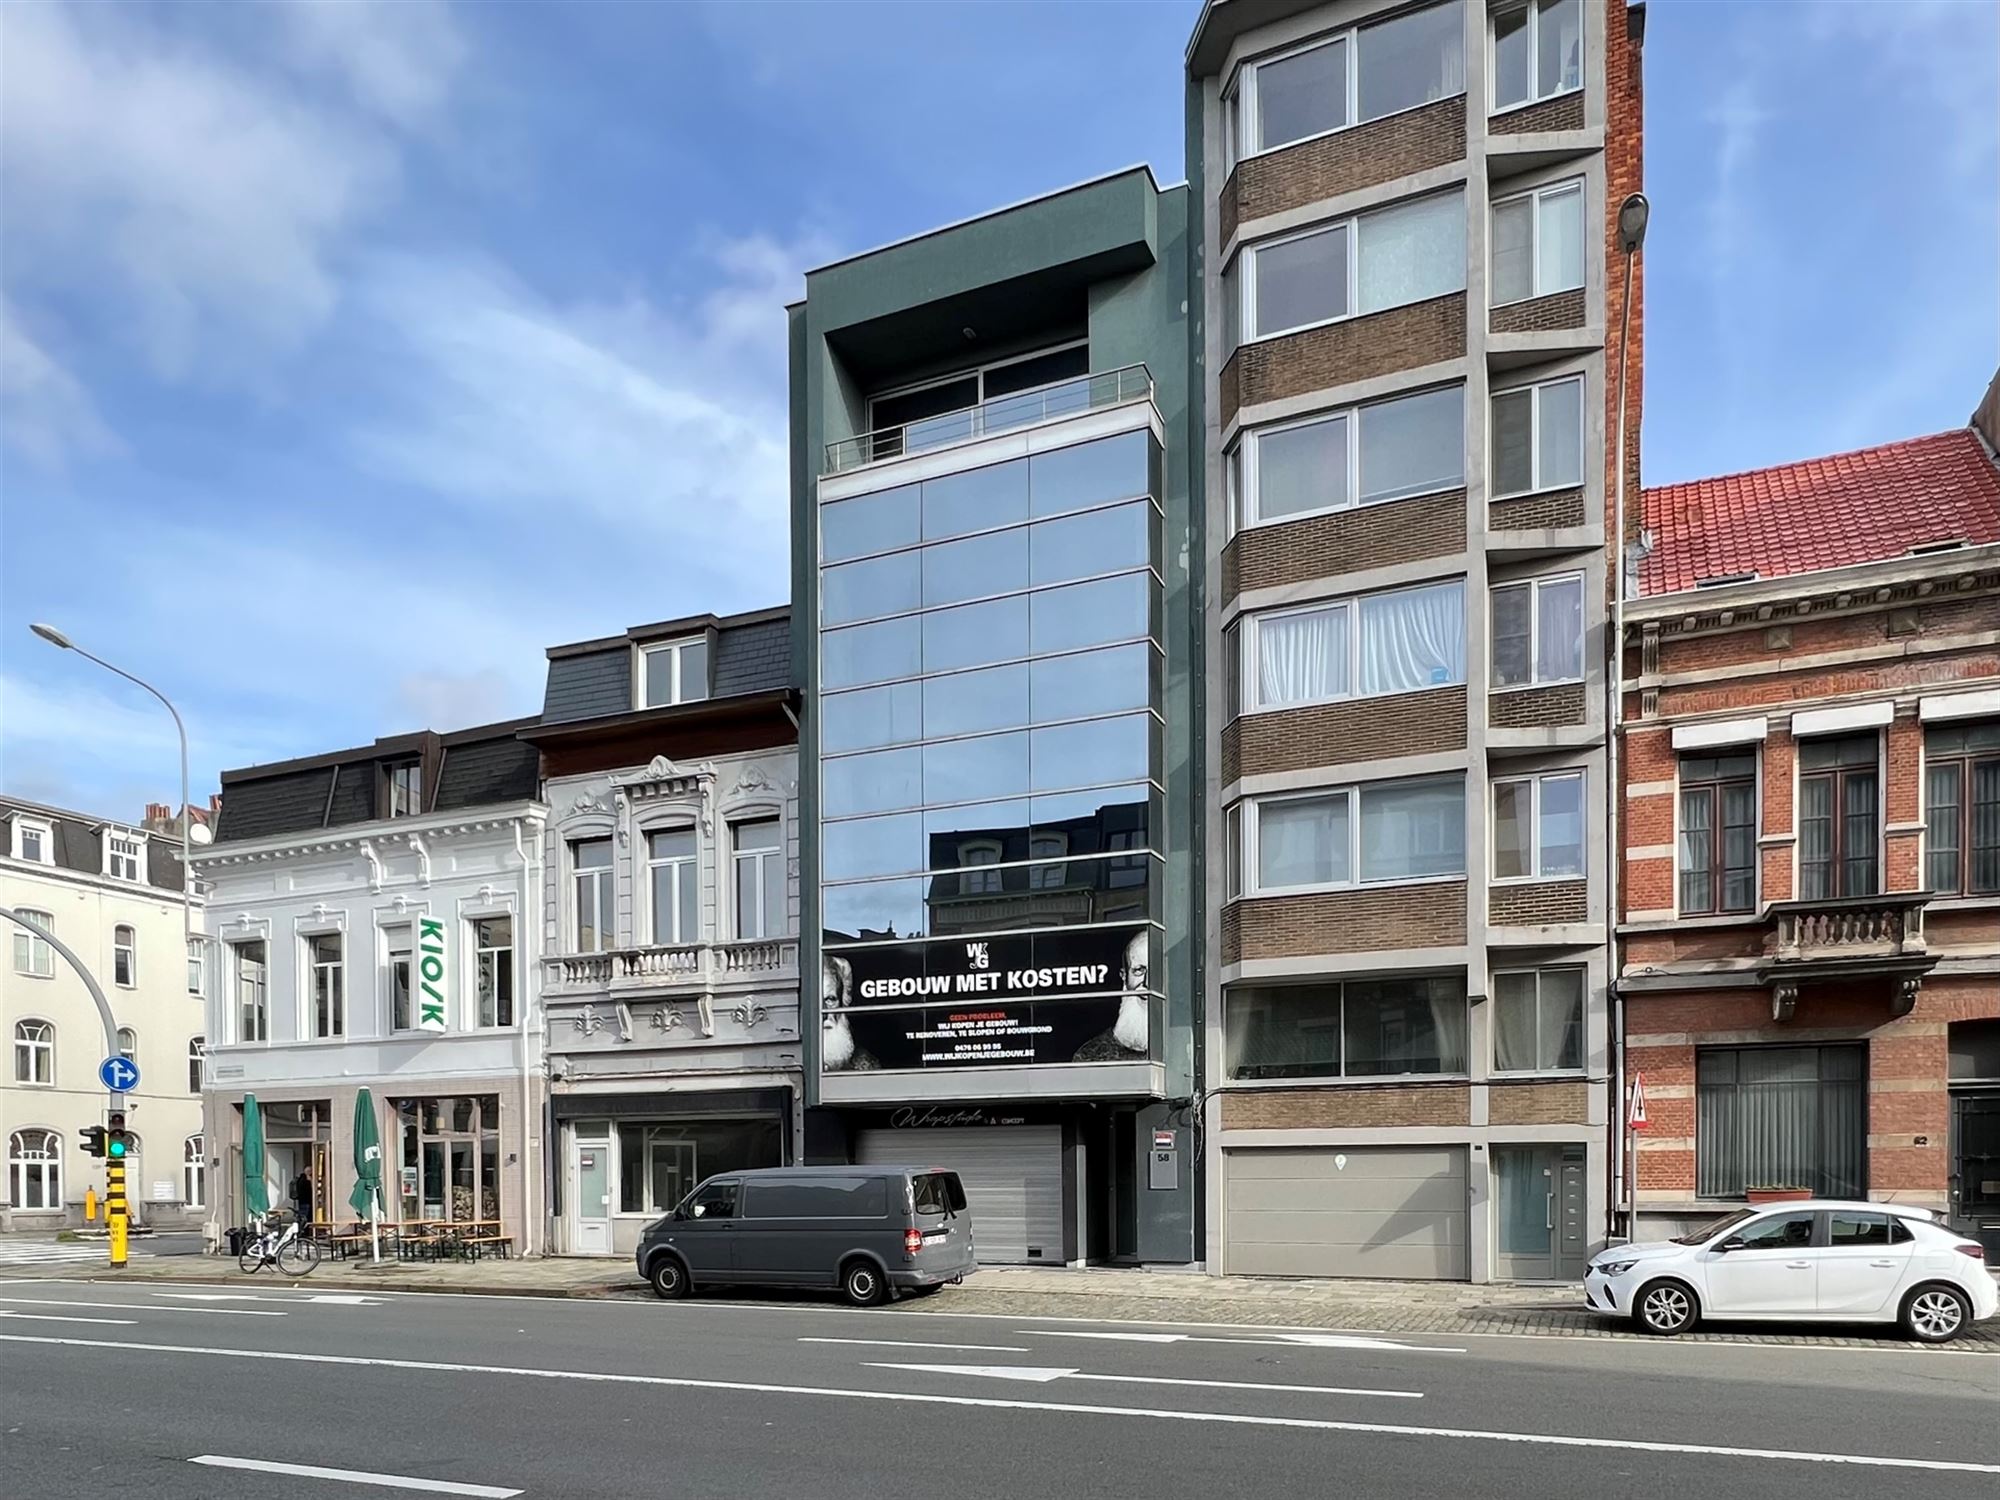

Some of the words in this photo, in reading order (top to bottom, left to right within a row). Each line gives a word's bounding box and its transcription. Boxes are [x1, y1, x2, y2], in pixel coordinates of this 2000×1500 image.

[860, 976, 949, 998] GEBOUW
[956, 972, 1001, 992] MET
[1007, 965, 1109, 989] KOSTEN?
[951, 1021, 975, 1029] KOPEN
[968, 1028, 995, 1037] SLOPEN
[1157, 1153, 1170, 1162] 58
